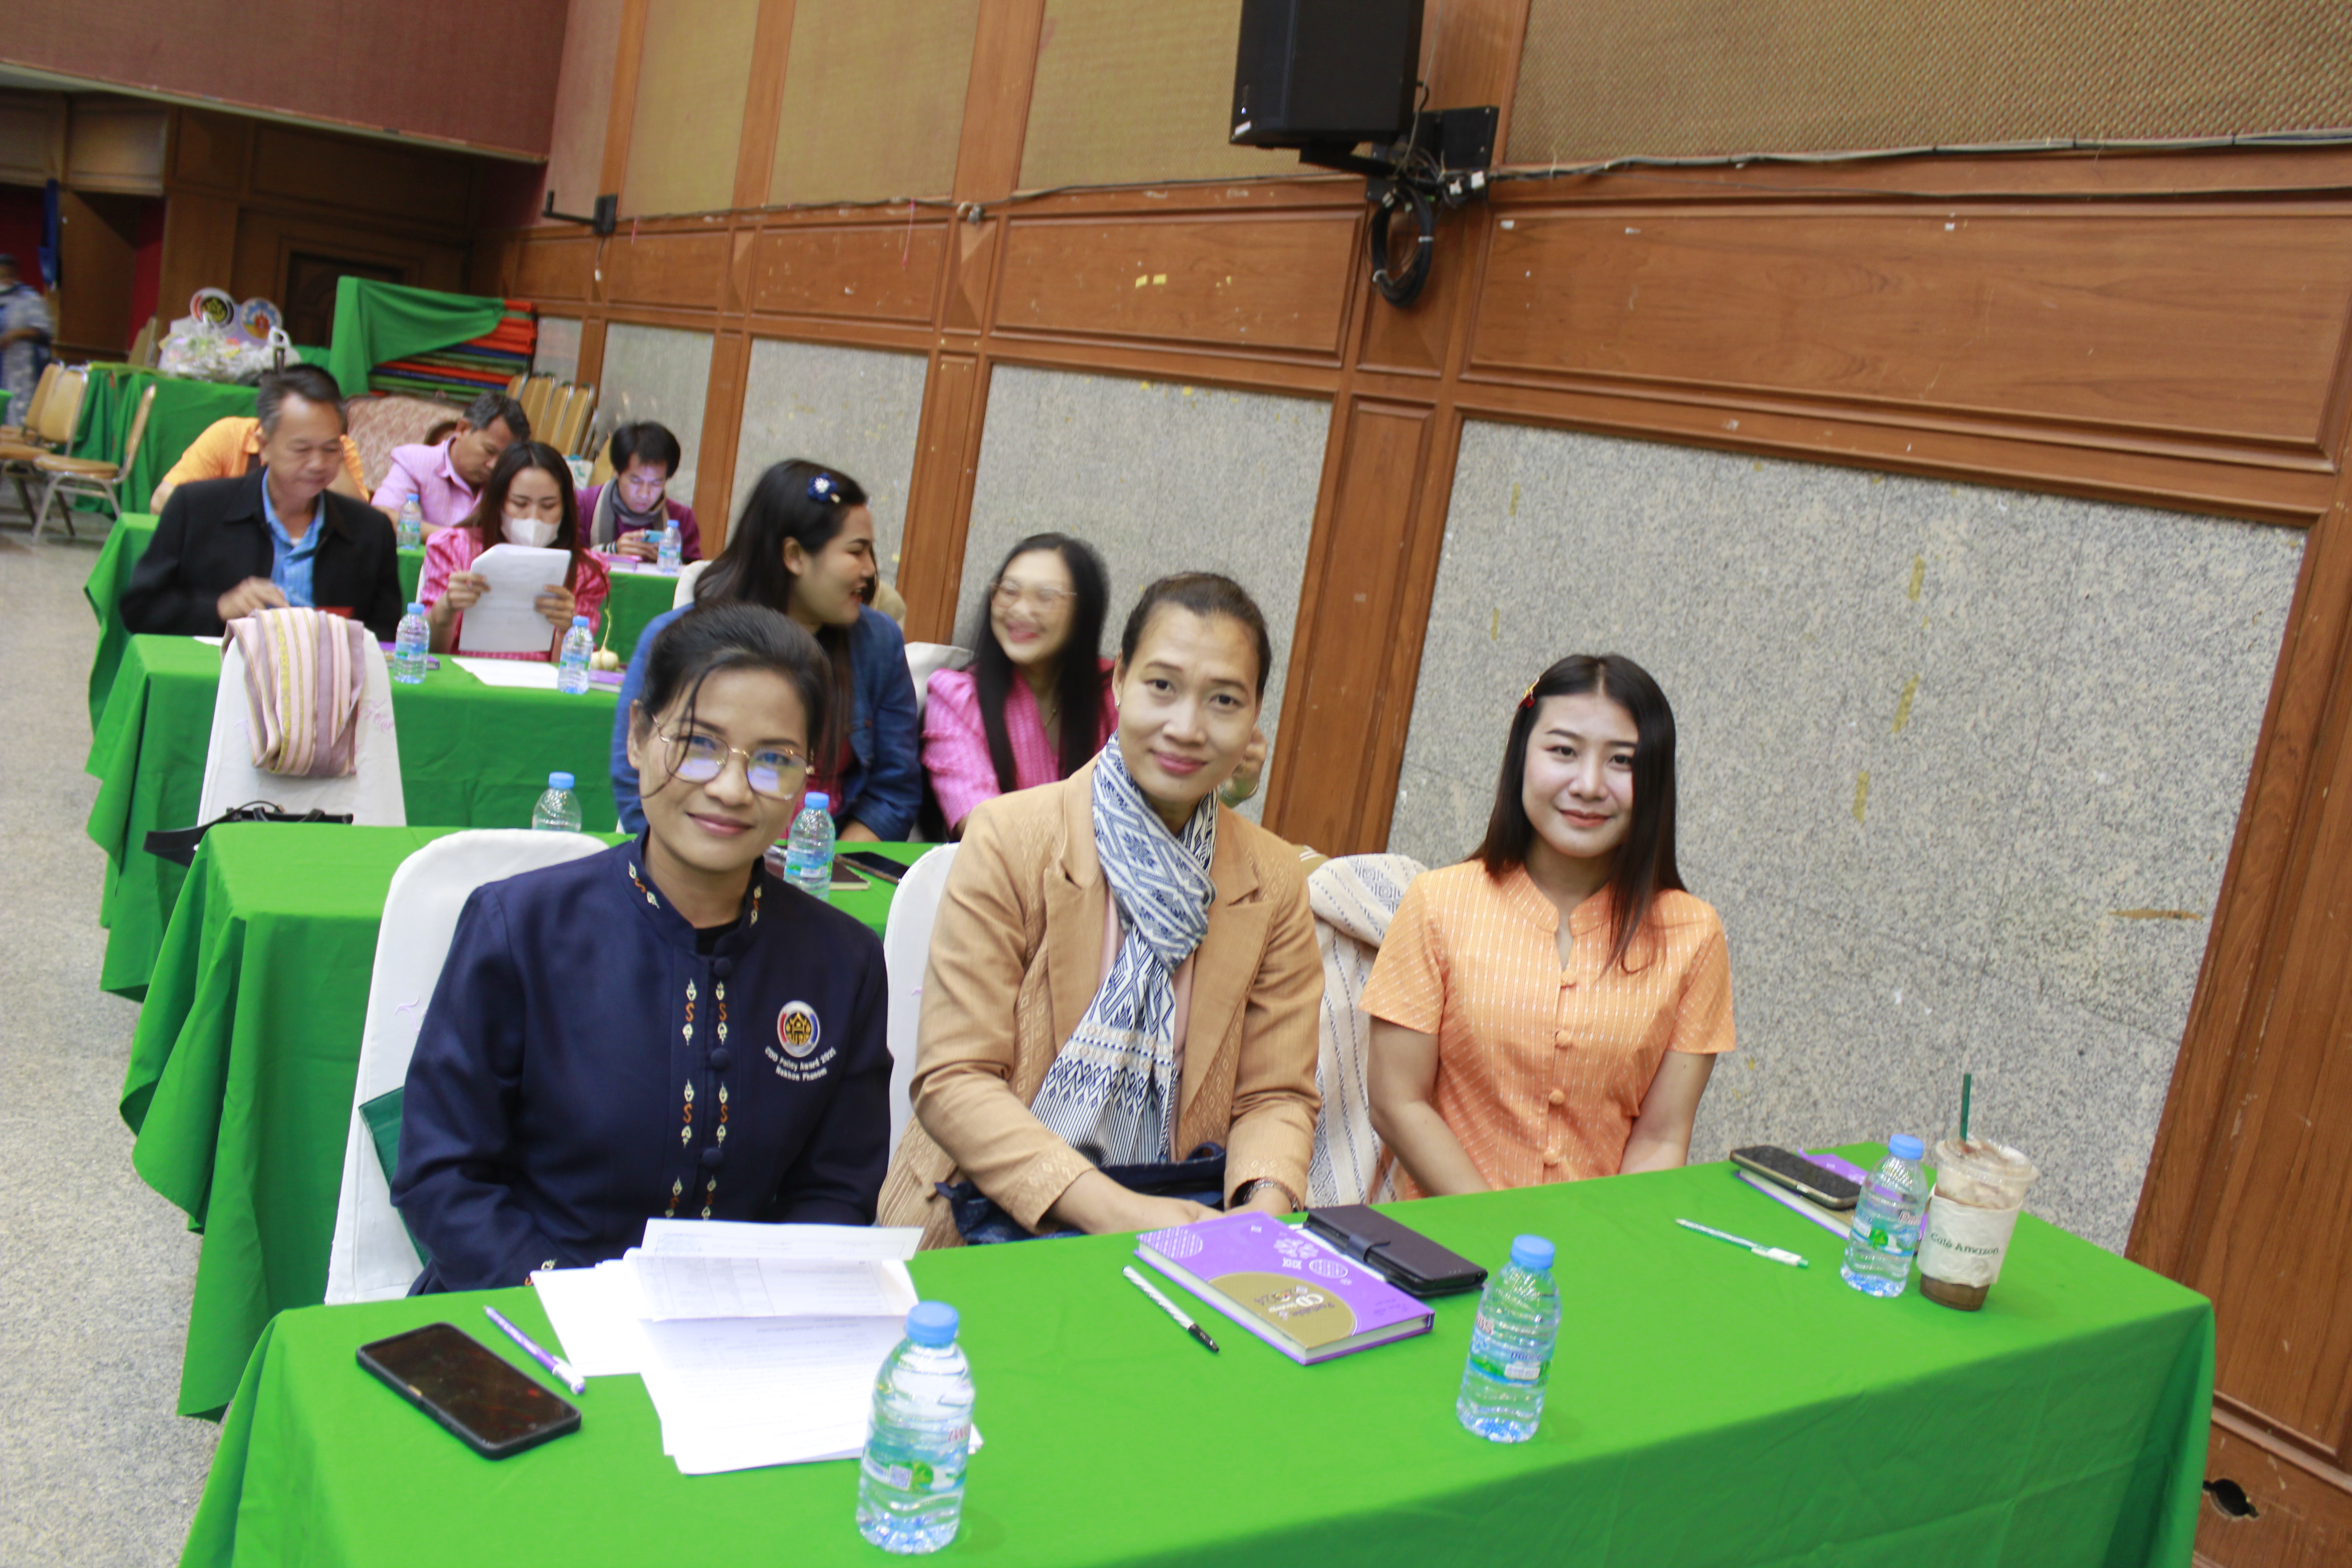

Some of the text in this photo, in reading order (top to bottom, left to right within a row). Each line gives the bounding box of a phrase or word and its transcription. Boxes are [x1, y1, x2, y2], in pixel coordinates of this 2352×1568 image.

[779, 1056, 798, 1072] Policy
[800, 1057, 820, 1071] Award
[775, 1064, 827, 1082] Nakhon Phanom
[1955, 1243, 1999, 1255] Amazon
